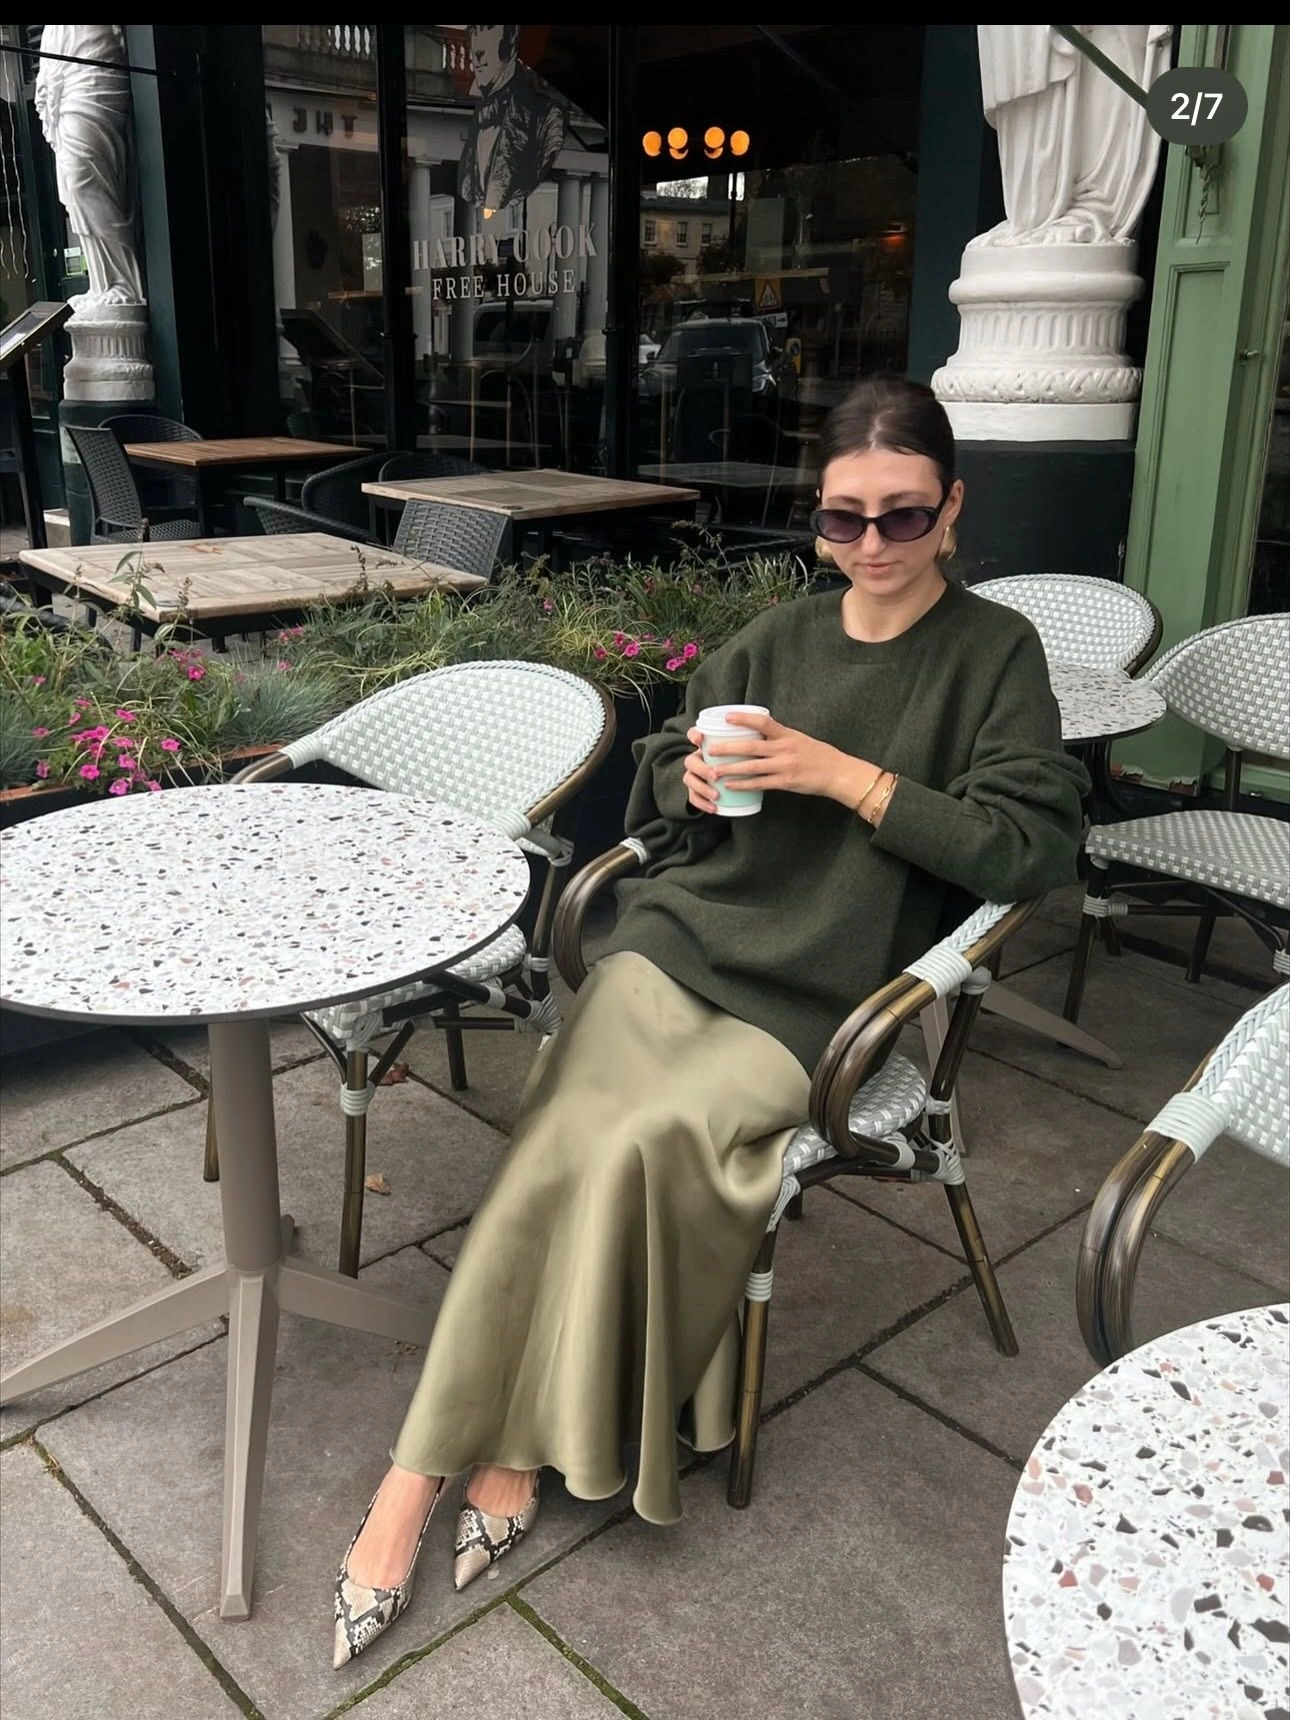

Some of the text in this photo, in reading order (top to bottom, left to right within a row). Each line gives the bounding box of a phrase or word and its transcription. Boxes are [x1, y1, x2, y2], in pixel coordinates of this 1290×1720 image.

[413, 222, 597, 270] HARRY COOK
[432, 269, 576, 300] FREE HOUSE
